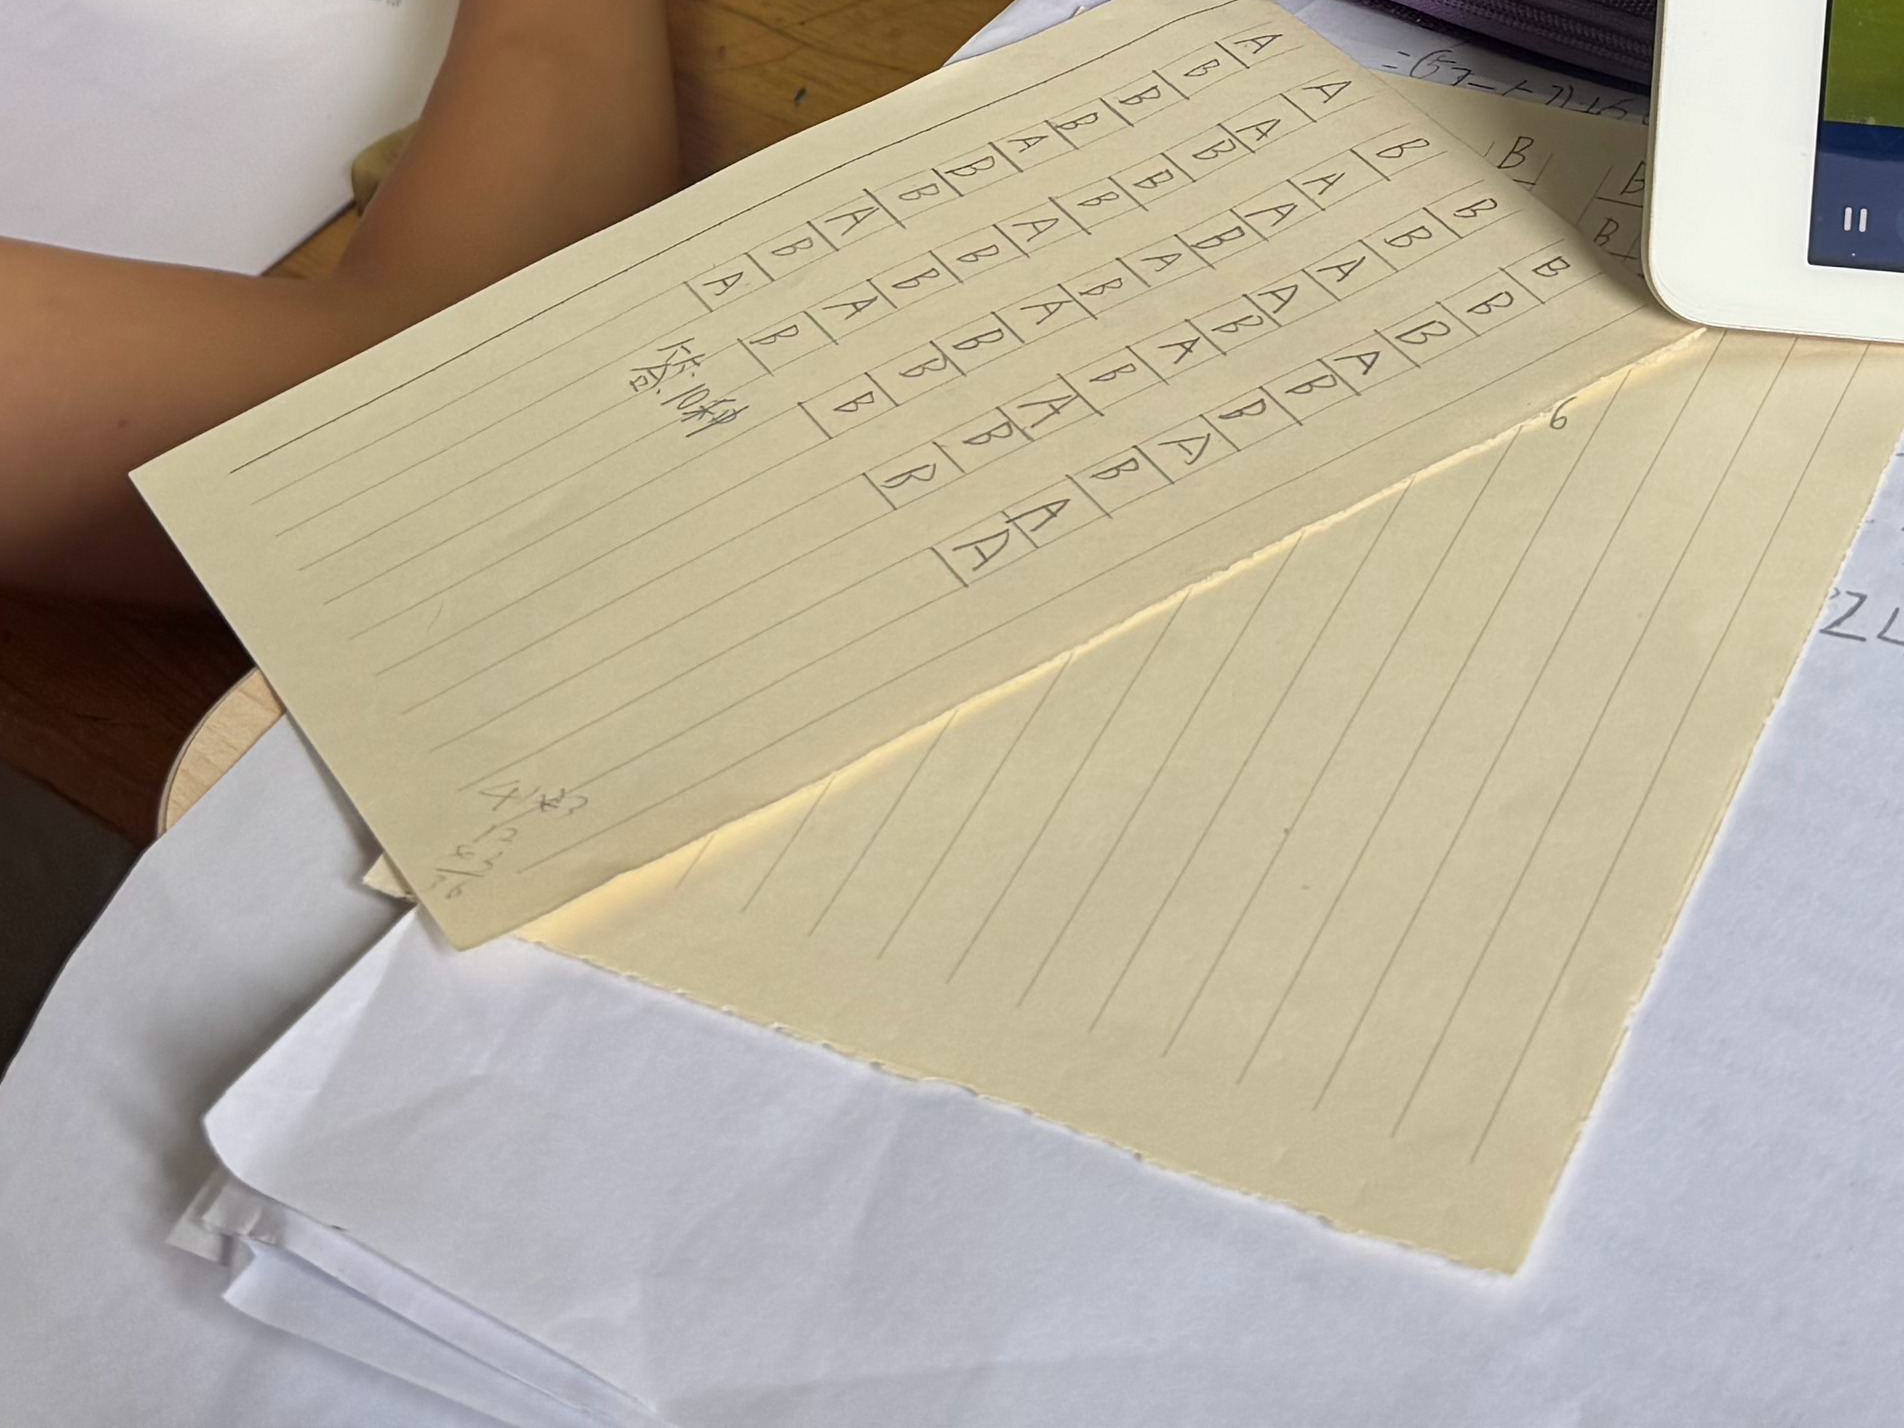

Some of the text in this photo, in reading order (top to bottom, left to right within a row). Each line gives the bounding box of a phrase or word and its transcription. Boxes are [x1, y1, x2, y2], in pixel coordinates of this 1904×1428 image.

[945, 152, 1267, 421] B A B A B
[1049, 111, 1381, 376] B B B A A
[1182, 55, 1516, 319] B A A B B
[1231, 33, 1571, 278] A A B B B
[824, 207, 1140, 481] A B B A B
